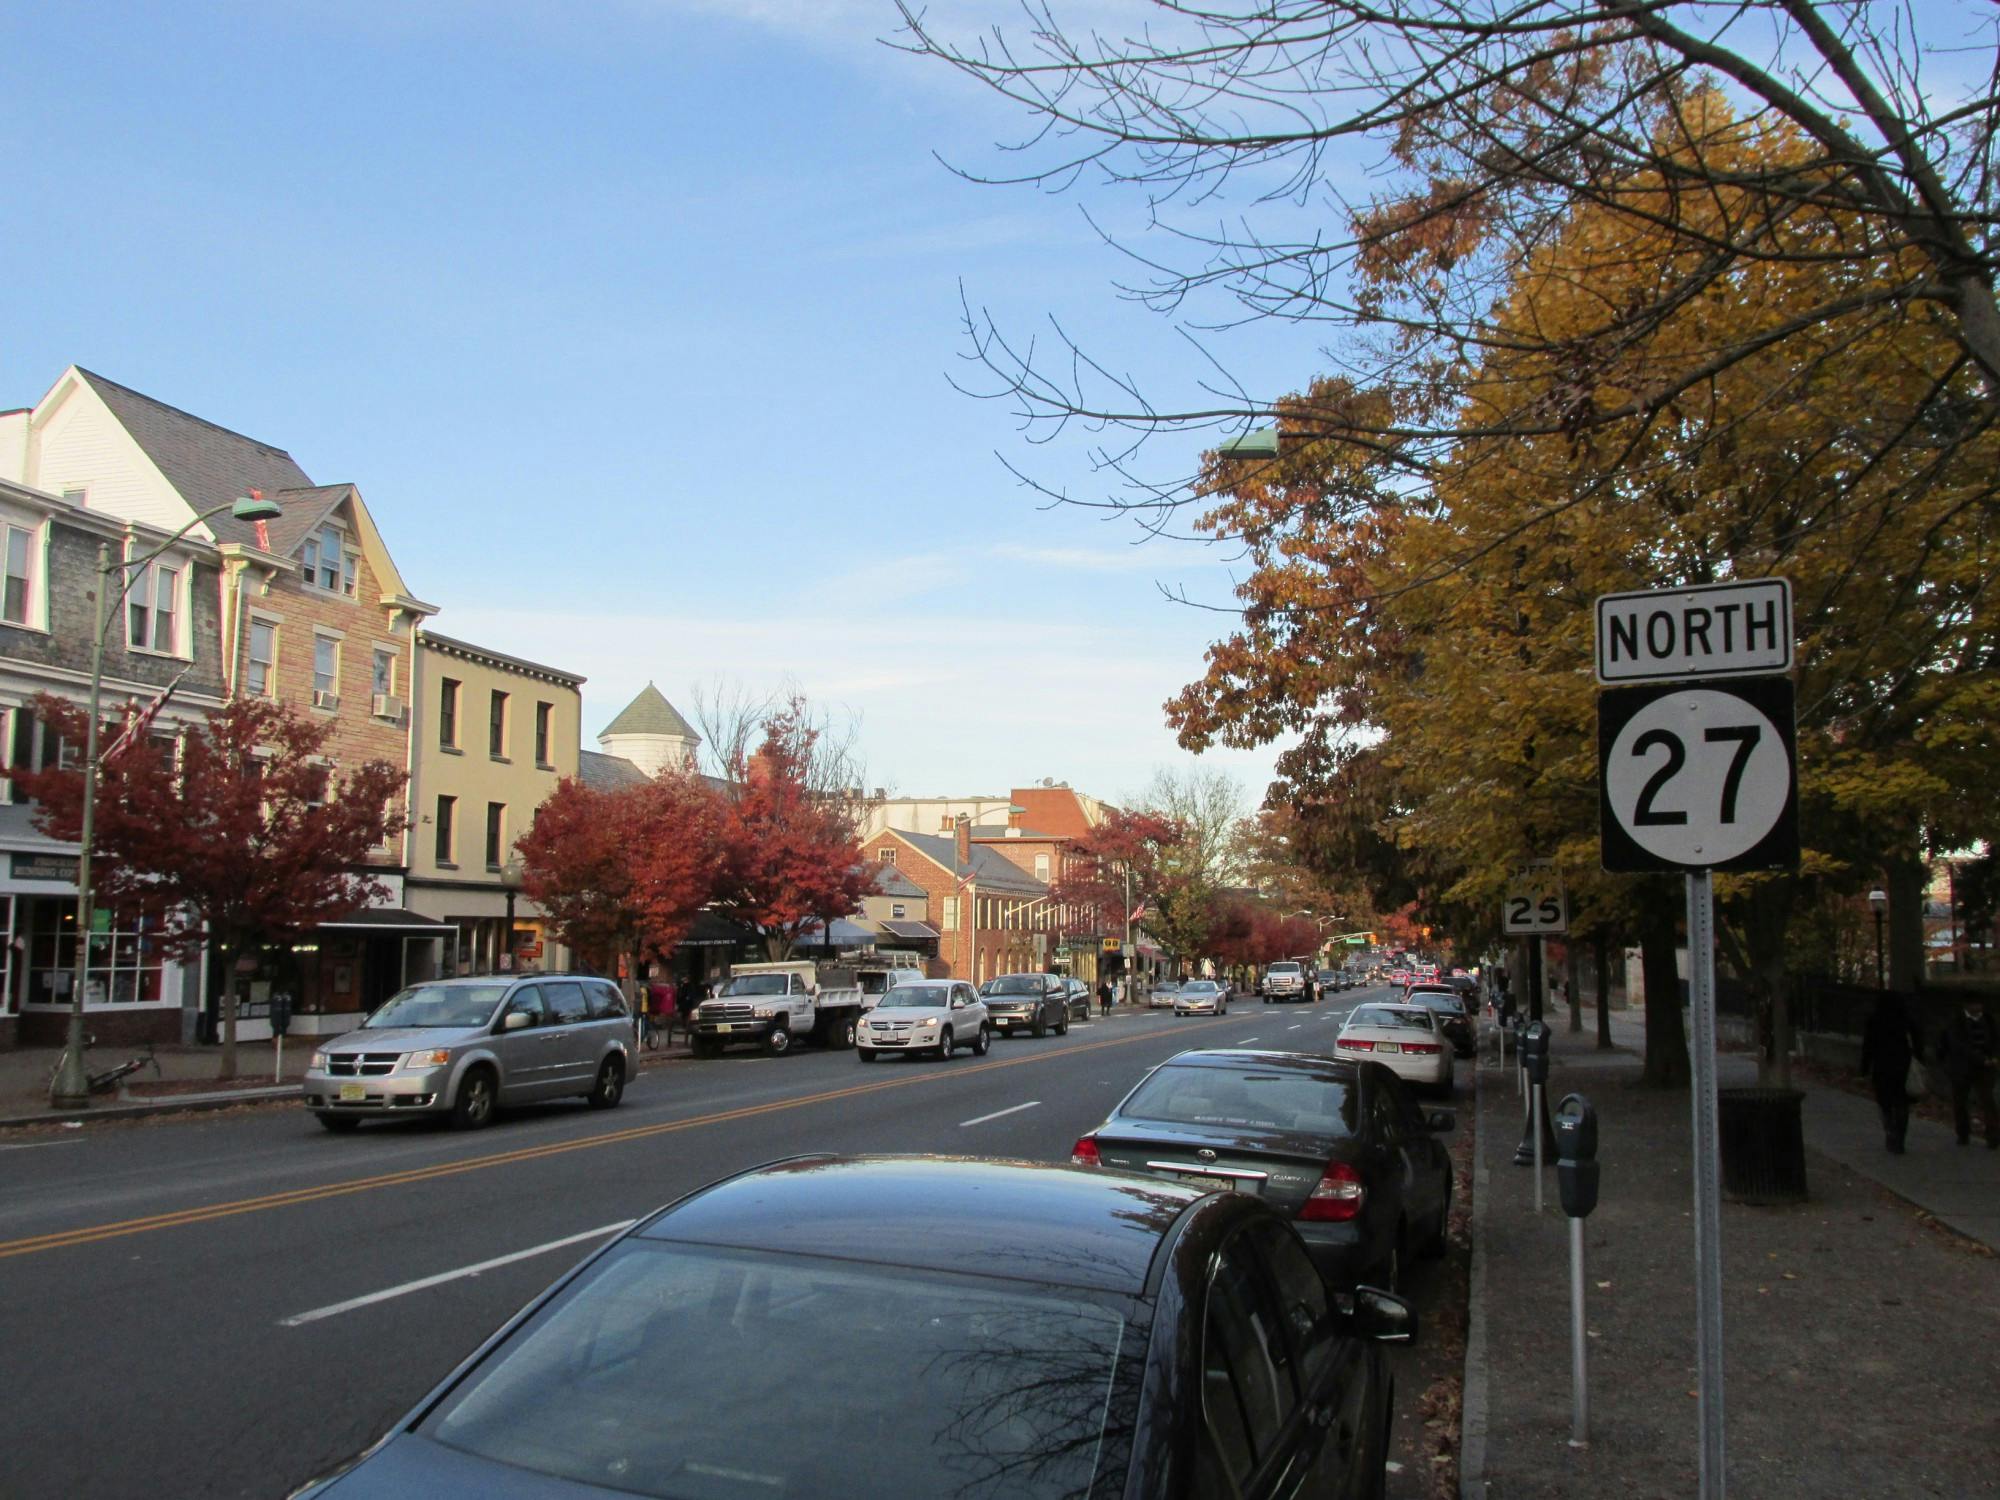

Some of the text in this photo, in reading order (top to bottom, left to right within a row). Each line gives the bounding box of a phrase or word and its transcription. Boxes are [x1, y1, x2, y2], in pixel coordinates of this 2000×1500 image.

[1610, 600, 1776, 662] NORTH
[1631, 725, 1761, 826] 27
[1510, 897, 1560, 924] 25
